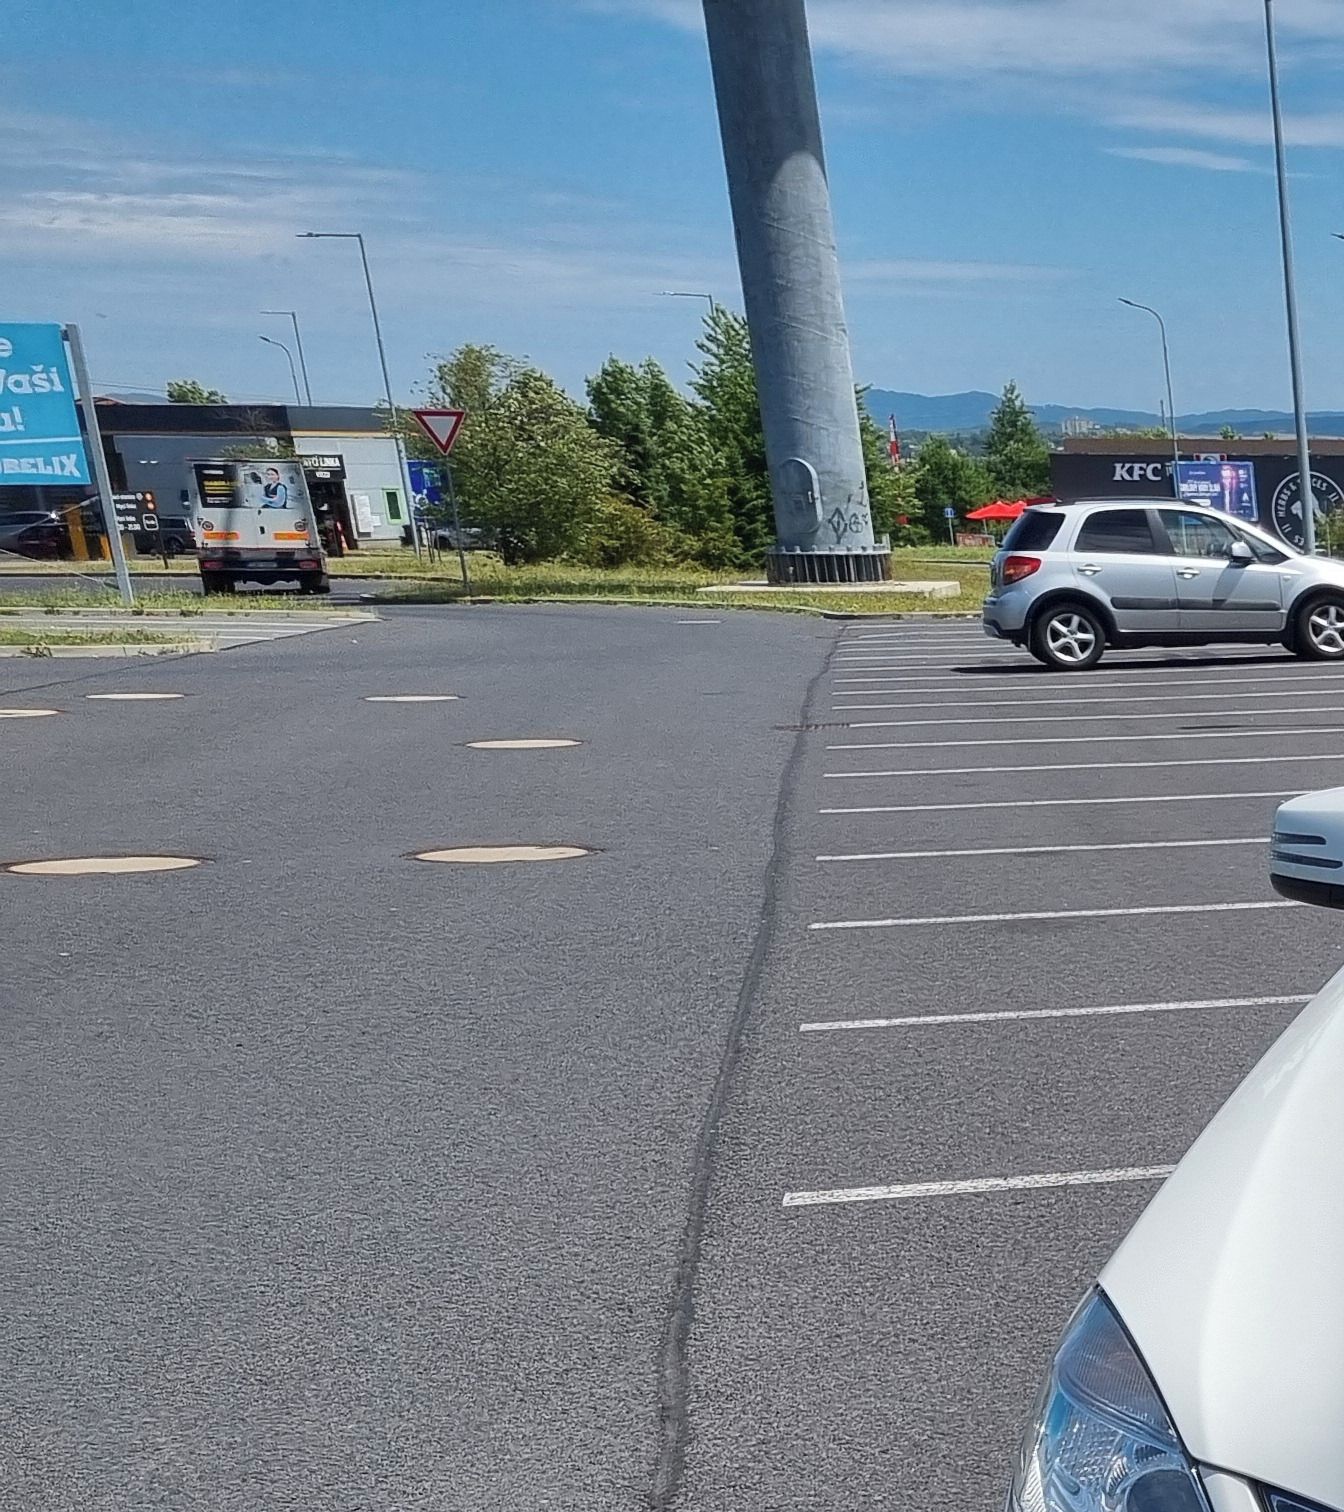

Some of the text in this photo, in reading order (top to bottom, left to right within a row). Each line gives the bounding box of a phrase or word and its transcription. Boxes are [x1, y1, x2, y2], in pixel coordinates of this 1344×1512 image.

[0, 454, 81, 478] BELIX
[1112, 462, 1162, 481] KFC
[1276, 488, 1291, 518] HERBS
